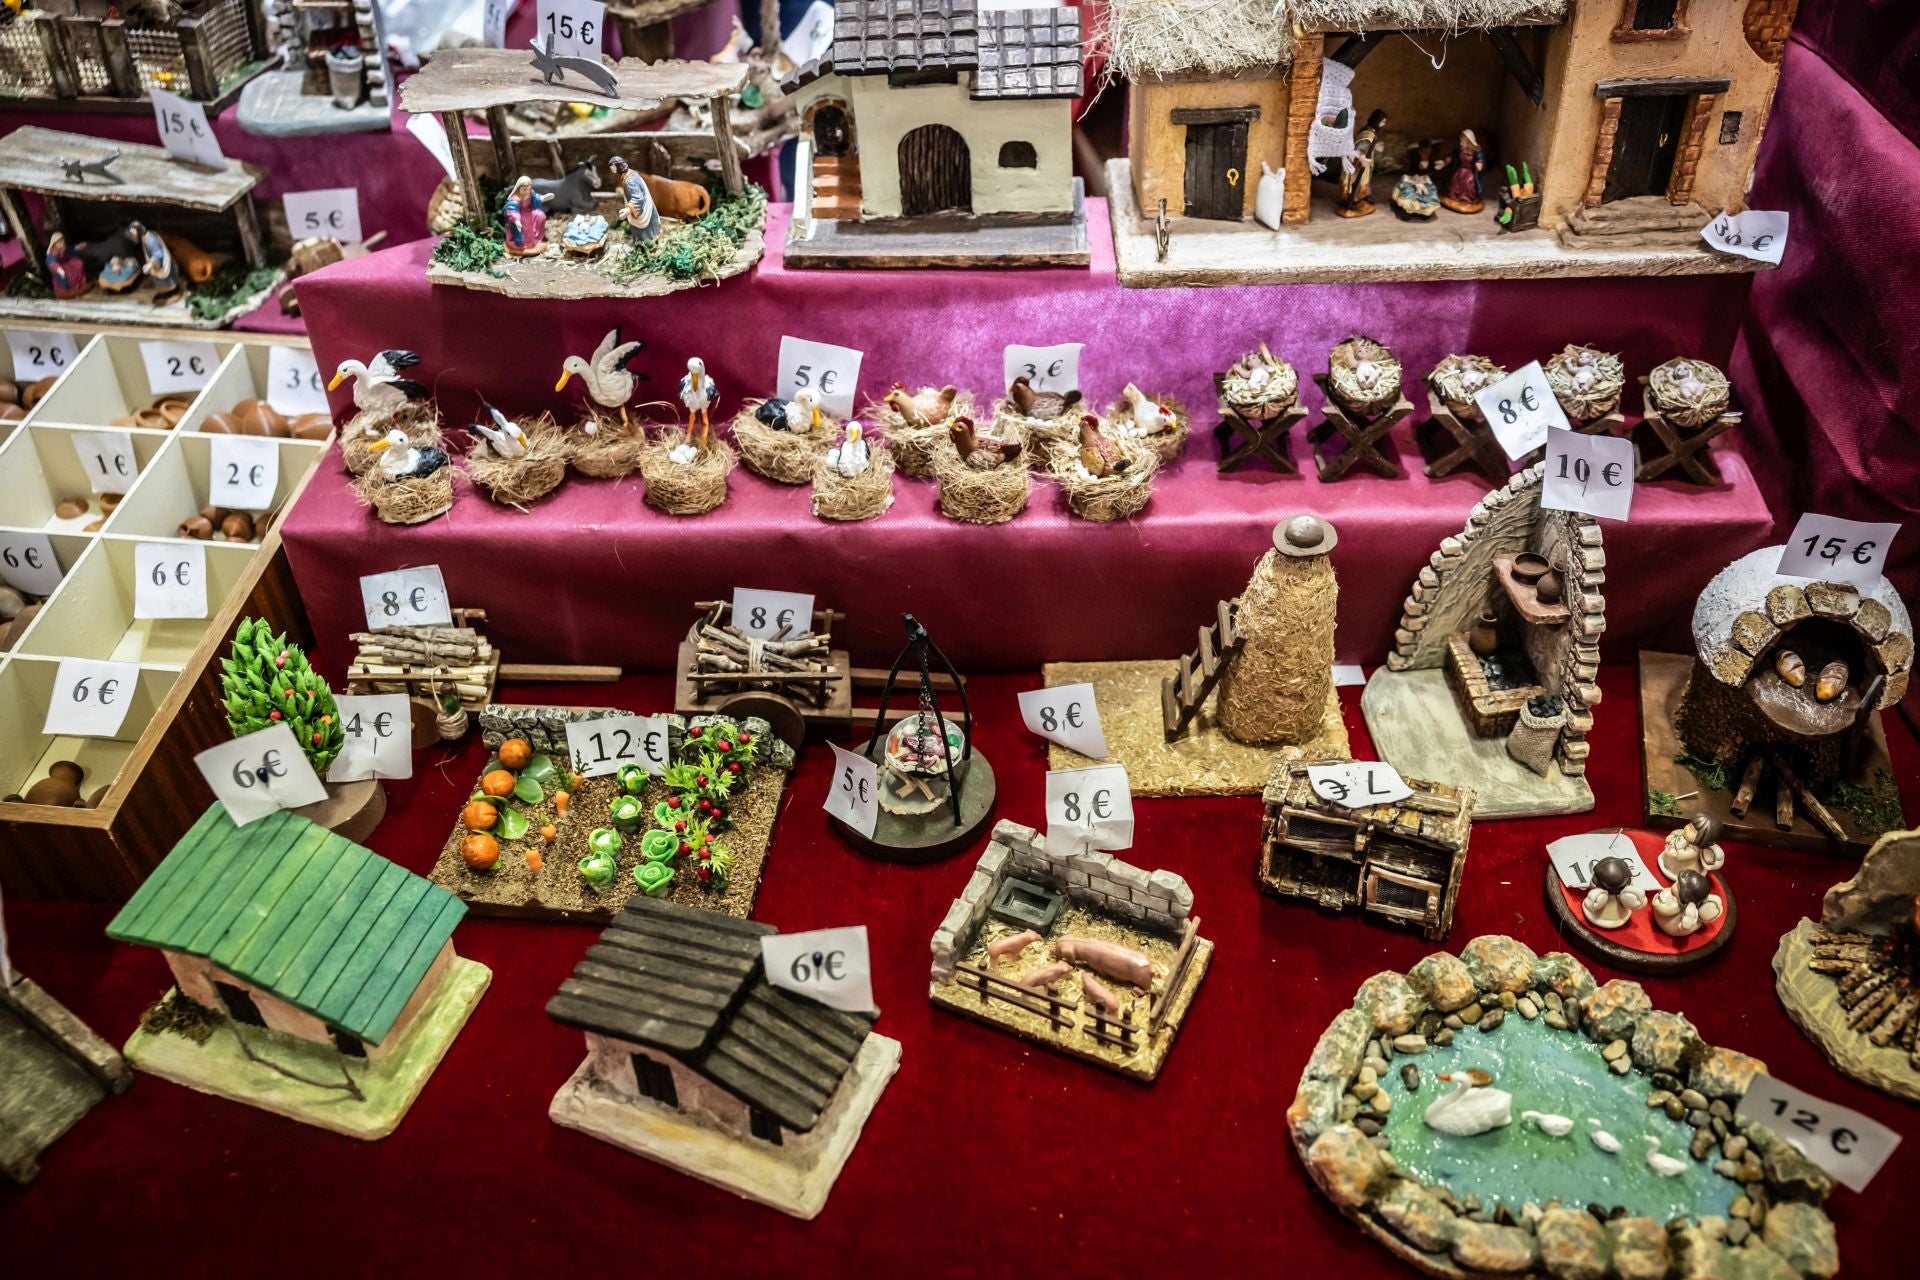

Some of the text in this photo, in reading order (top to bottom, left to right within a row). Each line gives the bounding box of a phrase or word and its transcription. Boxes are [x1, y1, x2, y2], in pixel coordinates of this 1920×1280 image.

[546, 12, 595, 45] 15 €
[162, 108, 185, 134] 15
[305, 212, 321, 230] 5
[29, 346, 65, 367] 2 €
[167, 355, 206, 377] 2 €
[286, 367, 301, 390] 3
[794, 365, 838, 394] 5 €
[1023, 363, 1037, 380] 3
[1498, 386, 1540, 425] 8 €
[95, 454, 129, 477] 1 €
[227, 463, 264, 487] 2 €
[1556, 454, 1622, 487] 10 €
[3, 547, 44, 569] 6 €
[1803, 534, 1877, 564] 15 €
[152, 561, 191, 586] 6 €
[382, 587, 429, 617] 8 €
[749, 606, 767, 630] 8
[73, 677, 120, 705] 6 €
[345, 711, 394, 738] 4 €
[1040, 702, 1084, 733] 8 €
[588, 729, 663, 763] 12 €
[232, 758, 256, 789] 6
[842, 767, 870, 804] 5 €
[1063, 789, 1113, 822] 8 €
[790, 950, 847, 983] 6 €
[1770, 1098, 1859, 1155] 12 €
